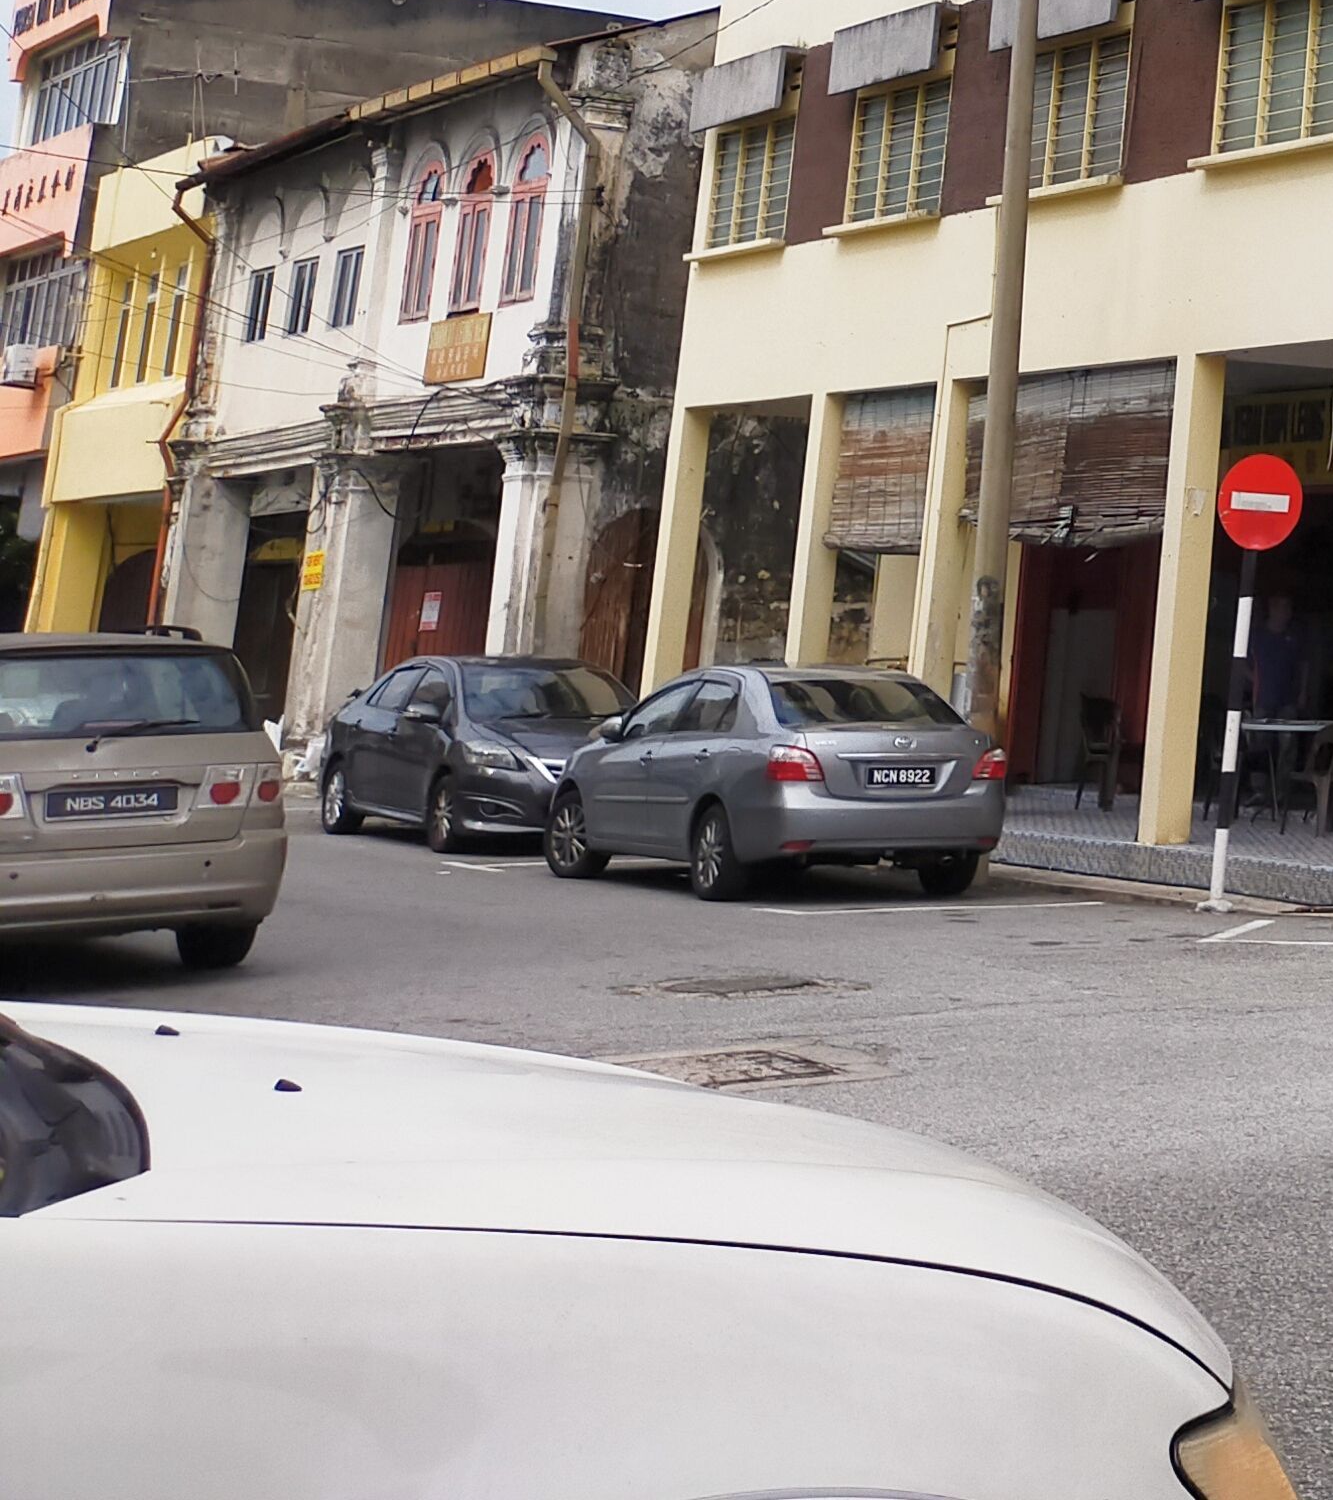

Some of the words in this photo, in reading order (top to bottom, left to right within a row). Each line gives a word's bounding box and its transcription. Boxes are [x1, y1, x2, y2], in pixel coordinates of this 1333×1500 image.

[873, 770, 898, 783] NCN
[899, 769, 930, 783] 8922
[66, 796, 105, 811] NBS
[110, 793, 159, 808] 4034
